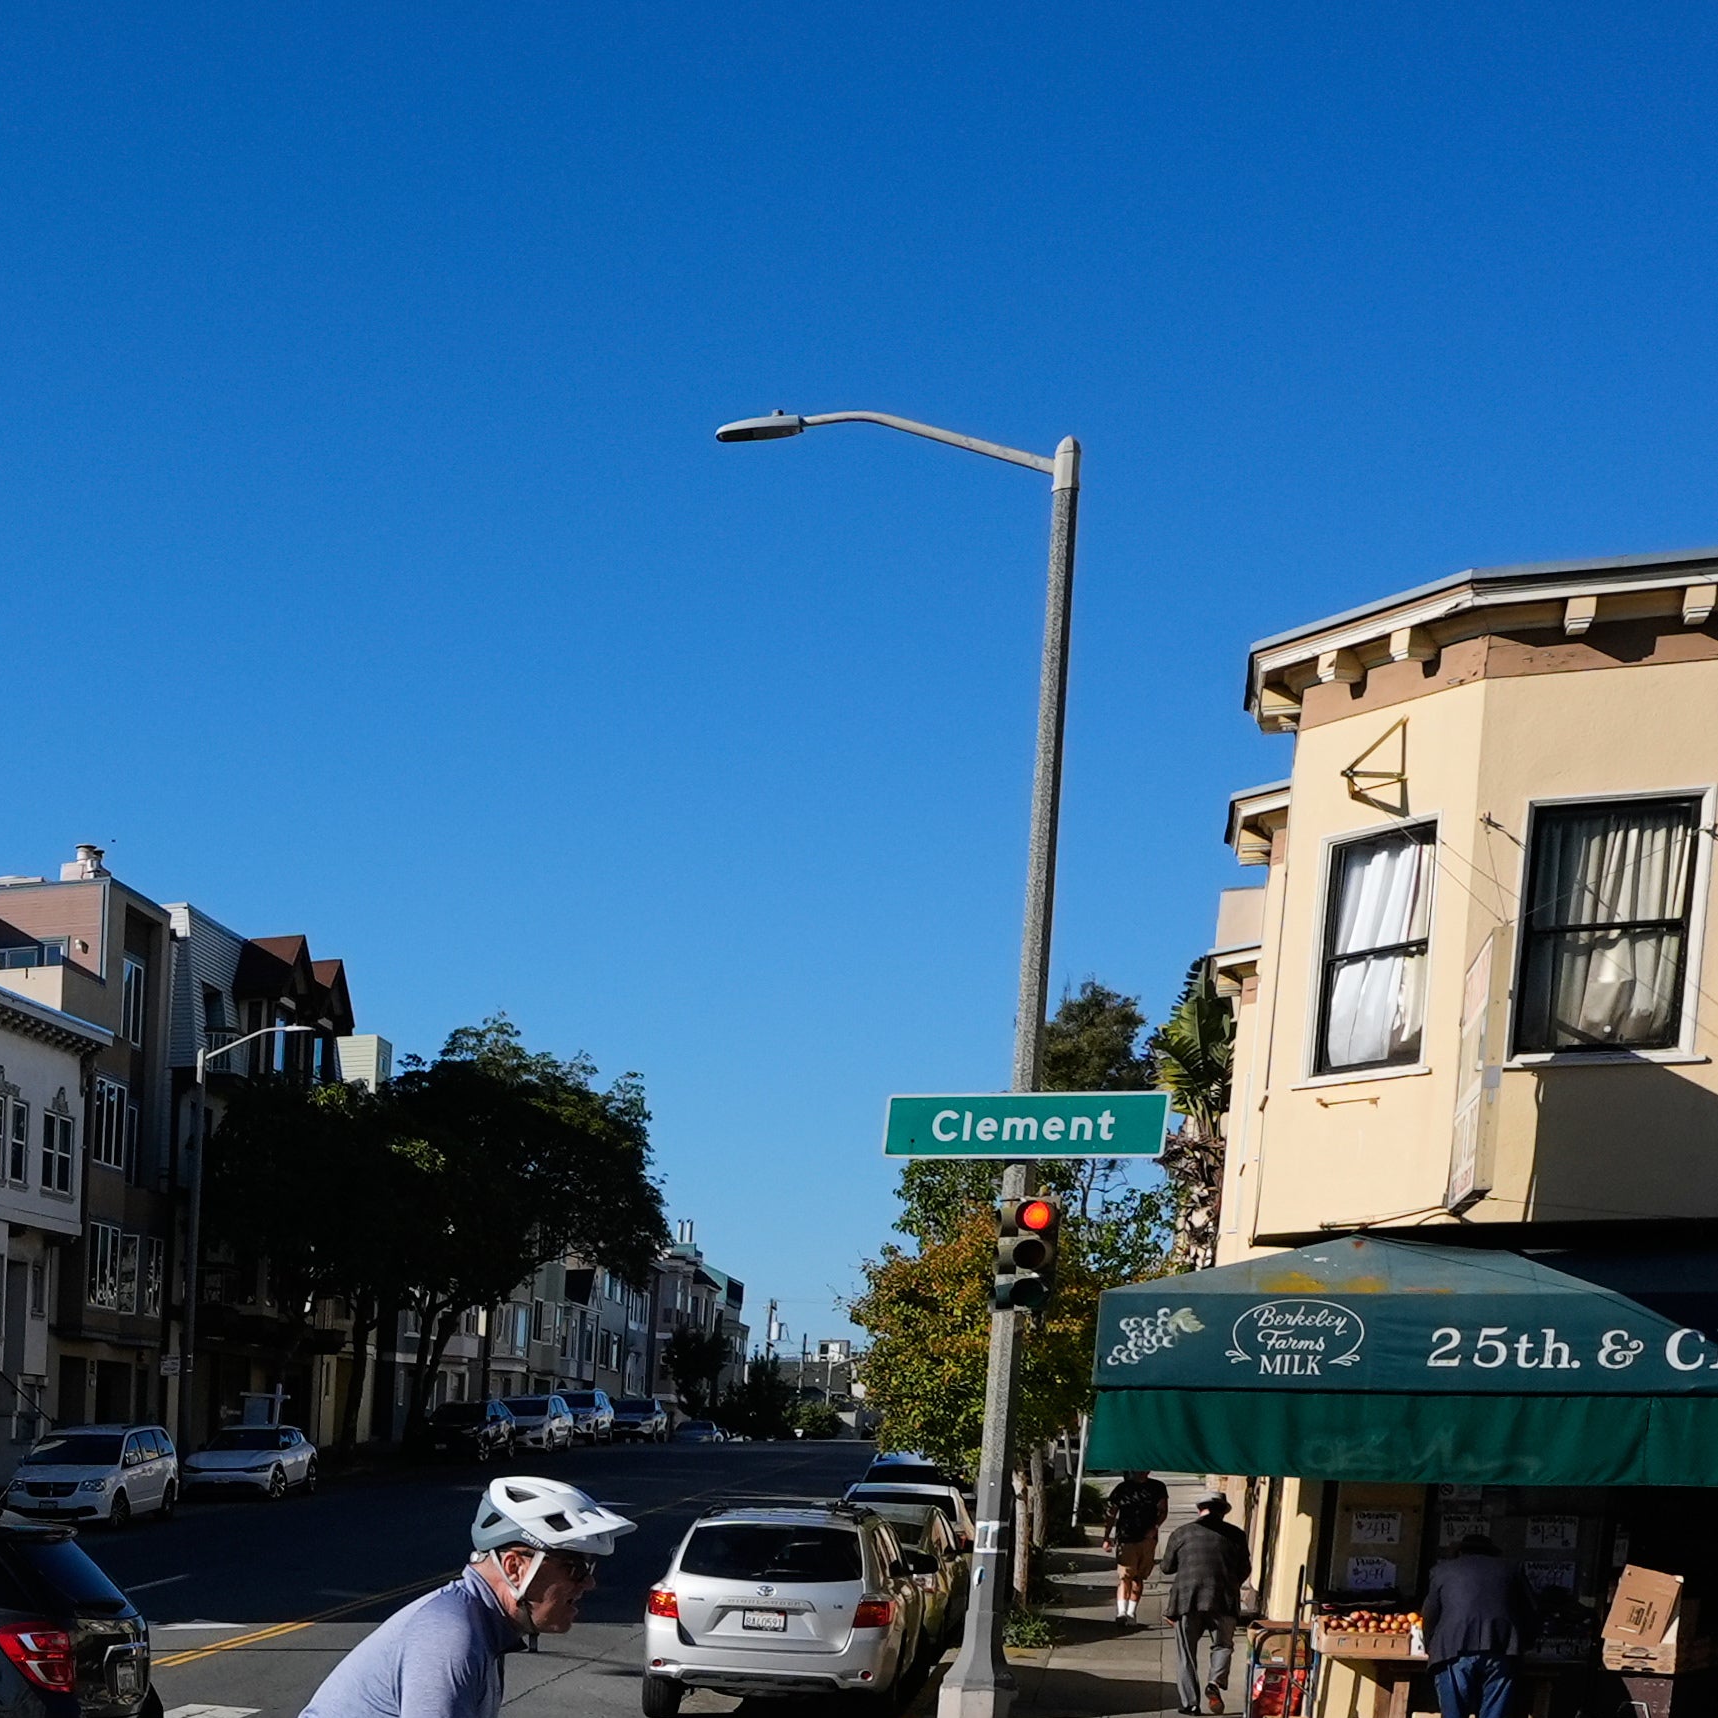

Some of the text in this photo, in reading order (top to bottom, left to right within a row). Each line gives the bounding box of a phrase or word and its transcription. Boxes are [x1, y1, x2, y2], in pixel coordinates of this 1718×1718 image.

[931, 1108, 1117, 1143] Clement
[1253, 1306, 1348, 1337] Berkeley
[1258, 1329, 1327, 1354] Farms
[1597, 1328, 1644, 1370] &
[1258, 1354, 1322, 1376] MILK
